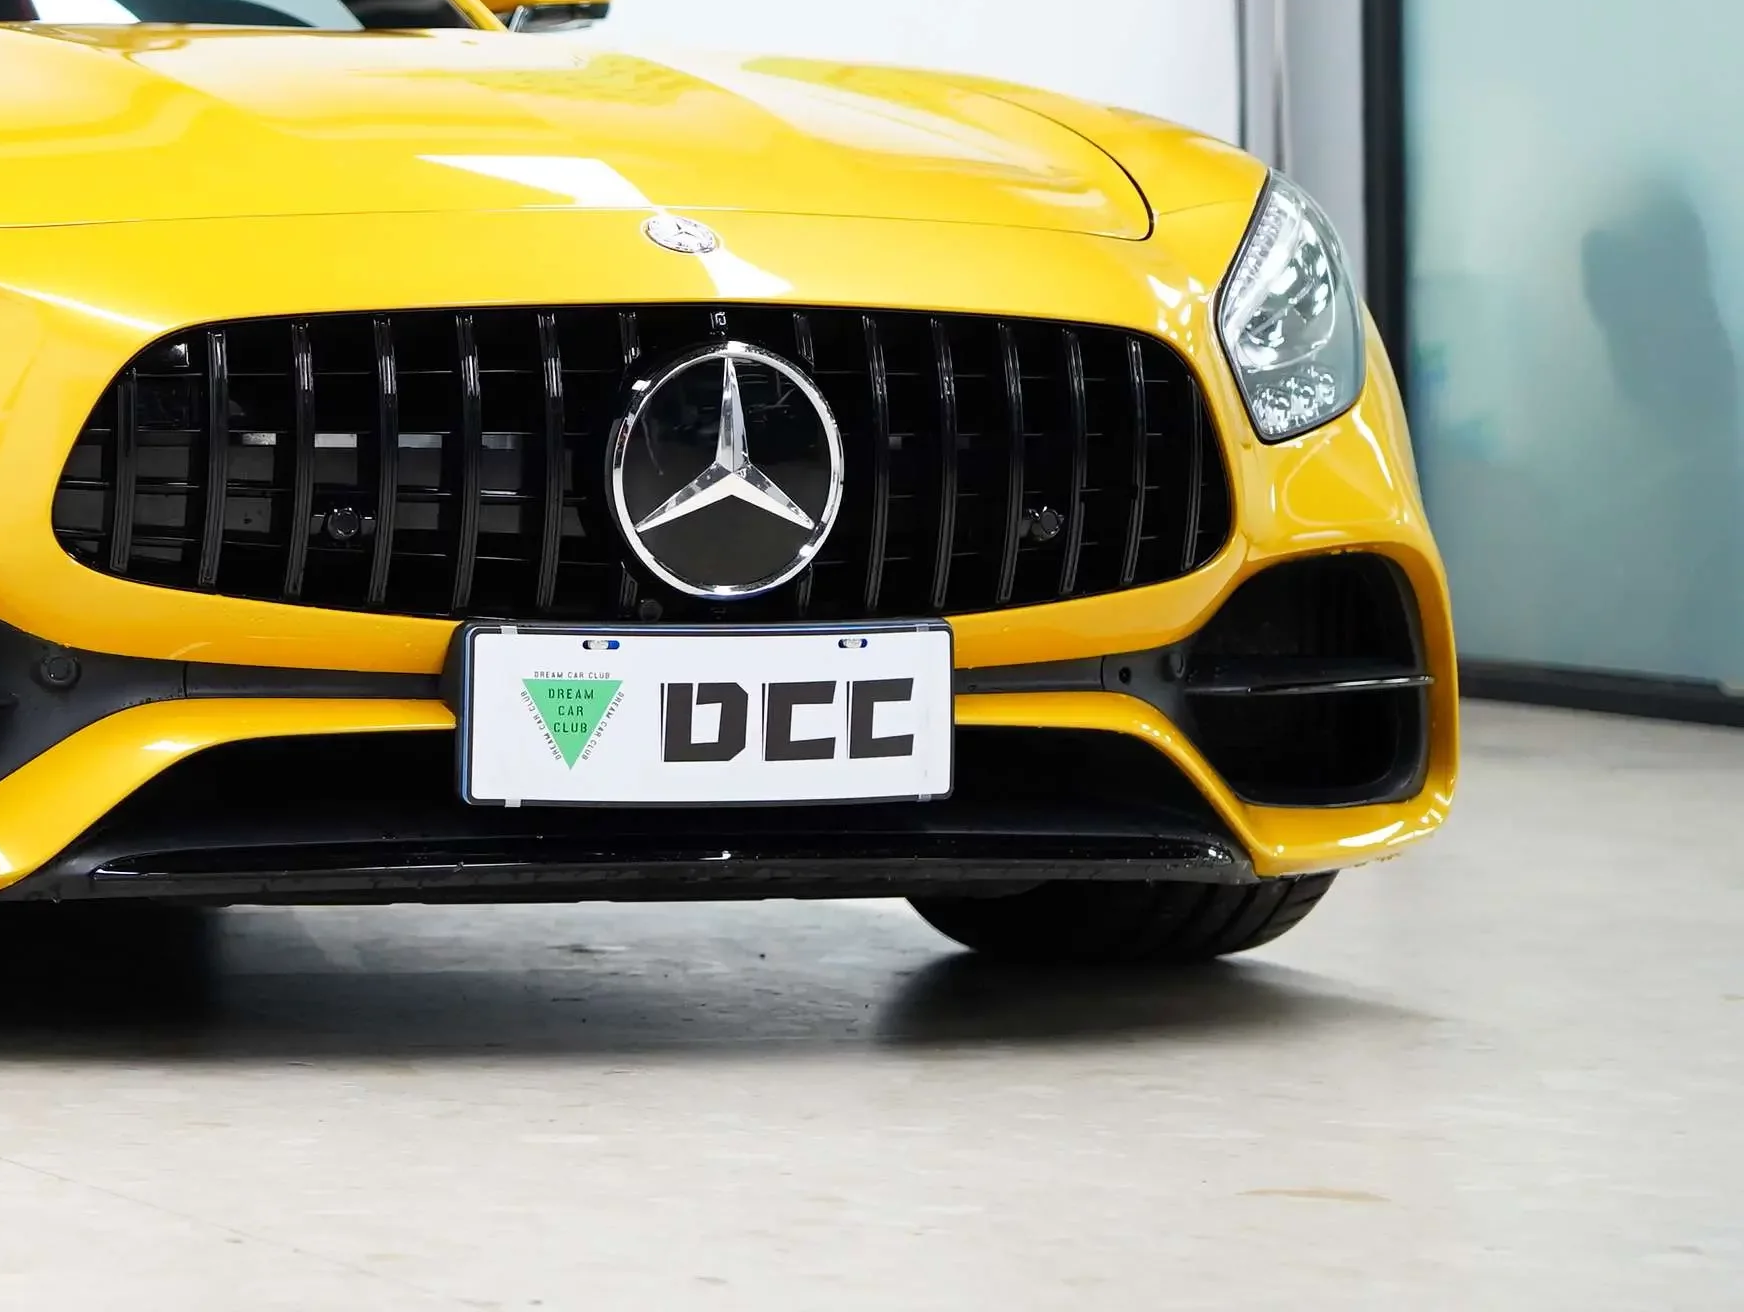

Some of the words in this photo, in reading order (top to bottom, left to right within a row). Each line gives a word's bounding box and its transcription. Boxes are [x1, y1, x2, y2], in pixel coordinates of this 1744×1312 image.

[548, 688, 594, 699] DREAM
[520, 690, 536, 712] CLUB
[558, 705, 584, 716] CAR
[660, 677, 914, 762] DCC
[553, 722, 588, 733] CLUB
